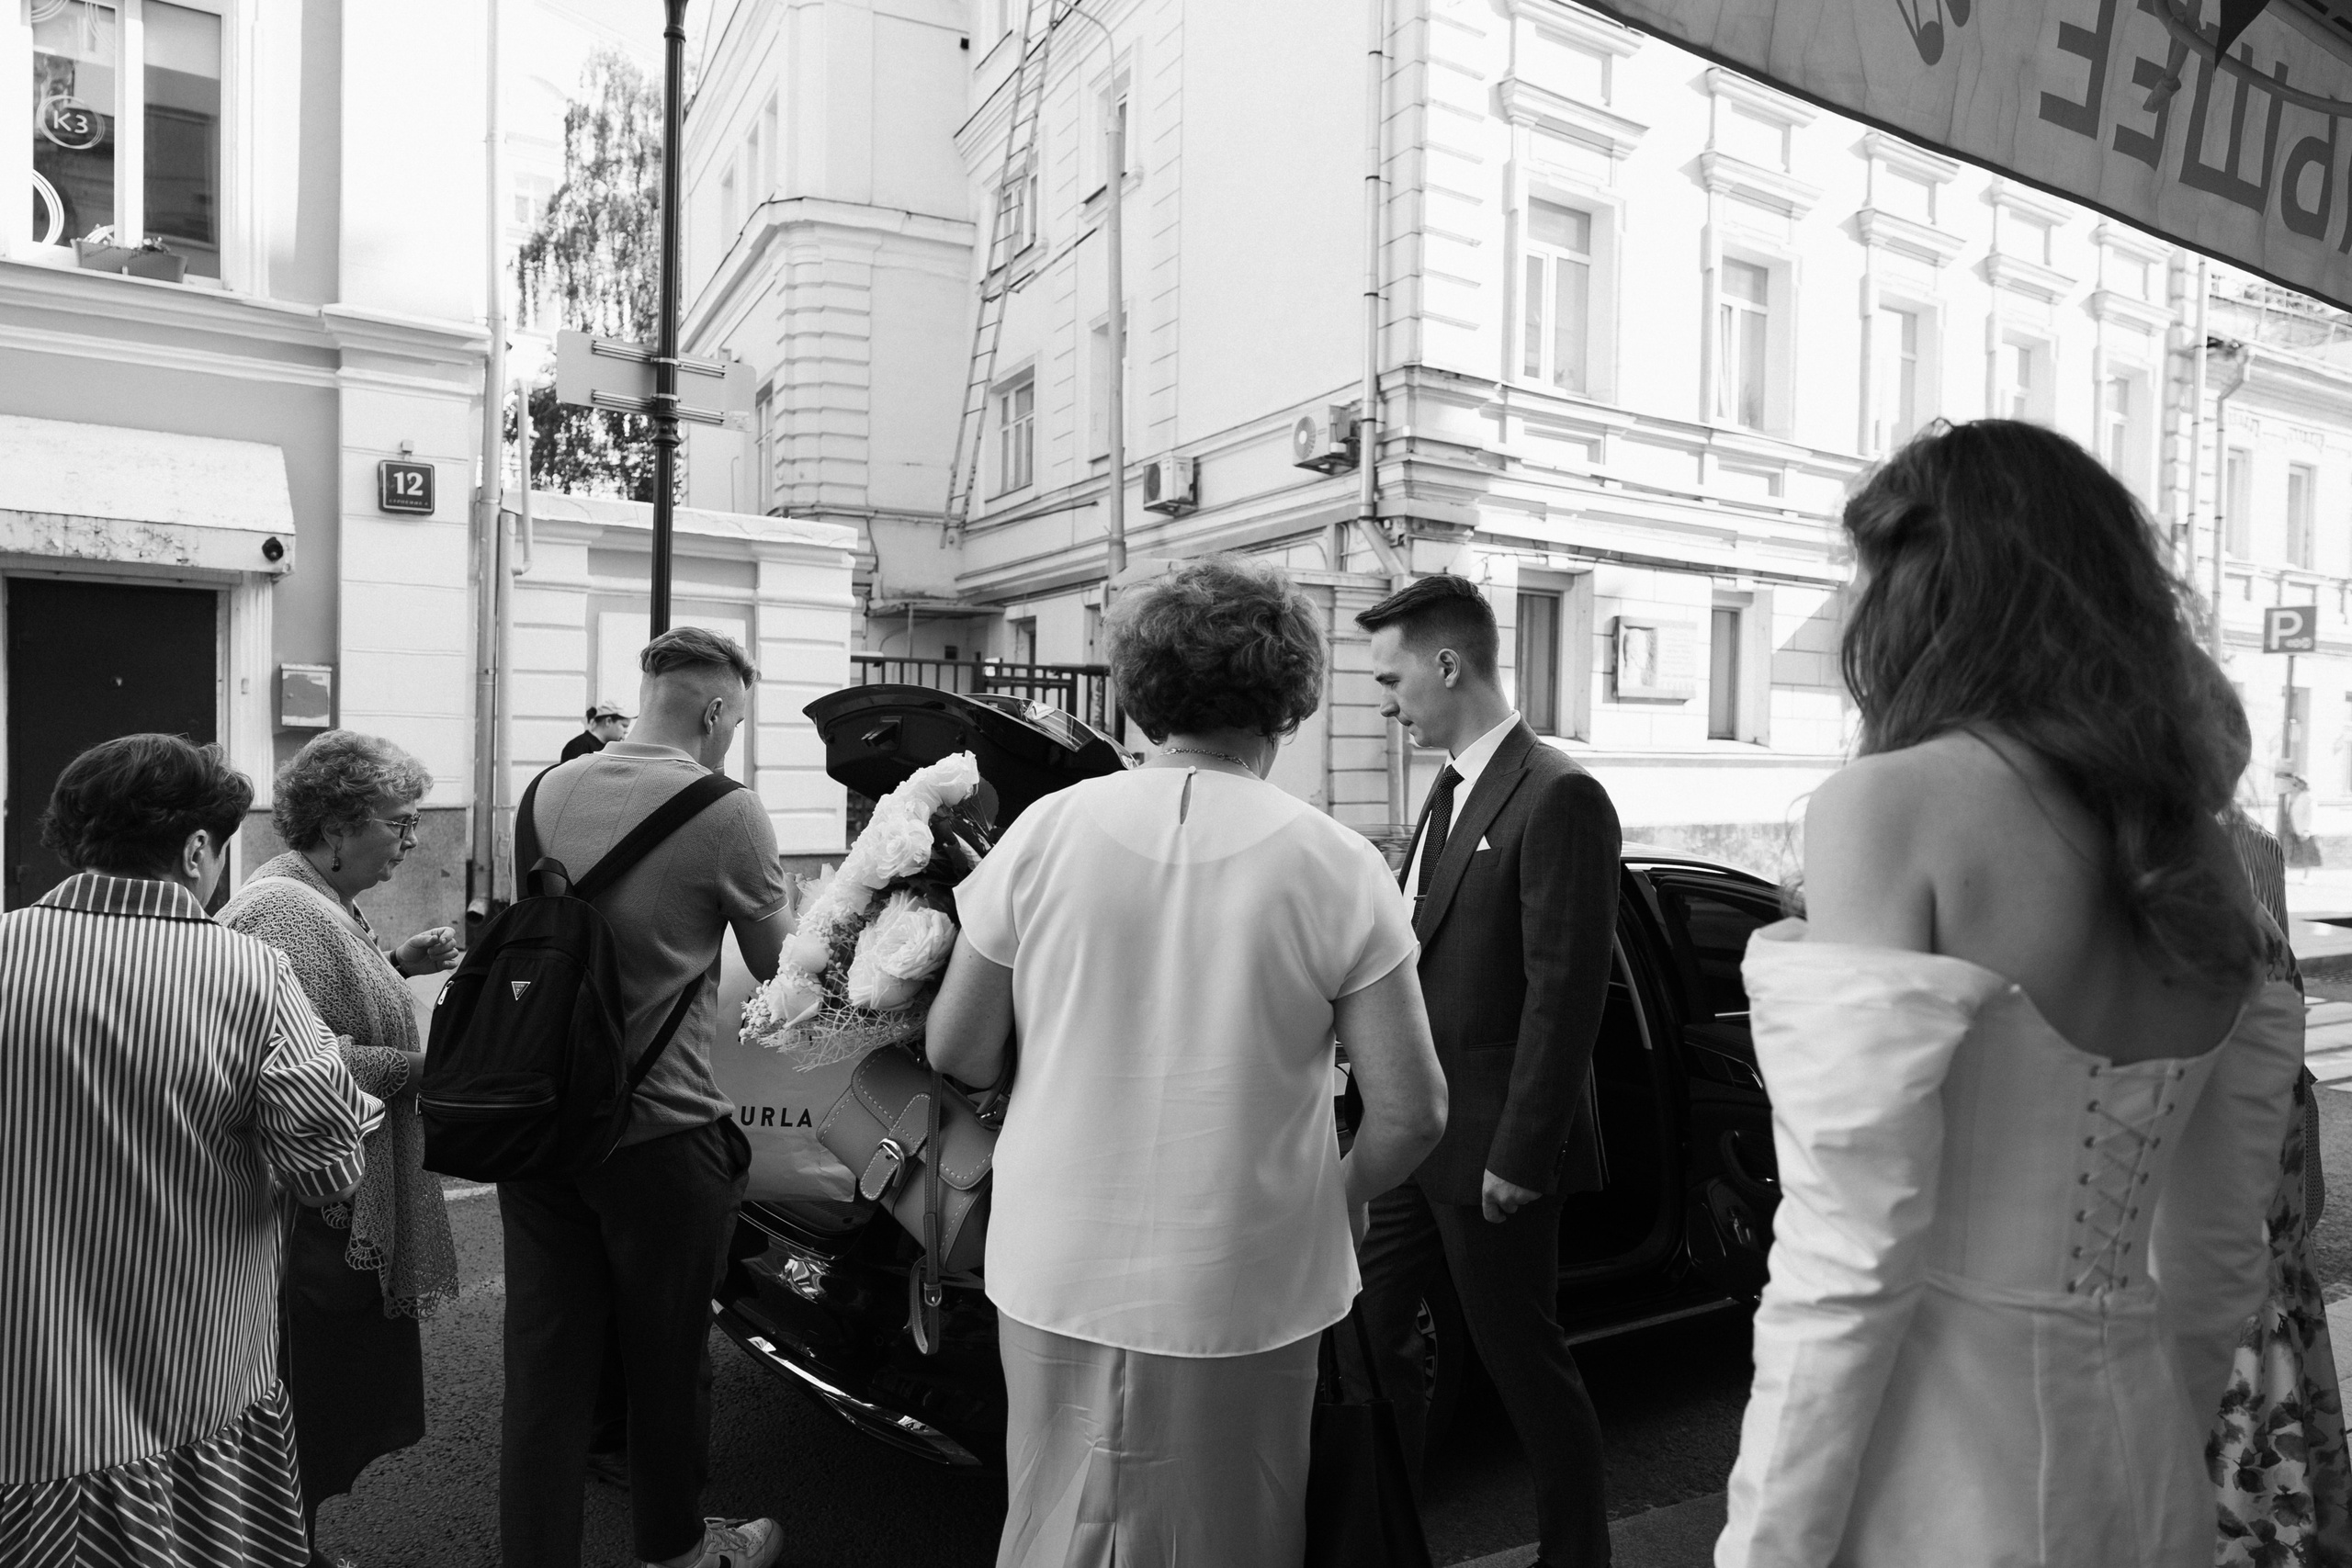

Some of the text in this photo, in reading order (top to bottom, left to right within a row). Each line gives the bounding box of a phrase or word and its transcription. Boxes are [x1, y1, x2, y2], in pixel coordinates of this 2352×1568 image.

[393, 471, 424, 496] 12
[2270, 610, 2303, 650] P
[729, 1105, 812, 1128] URLA
